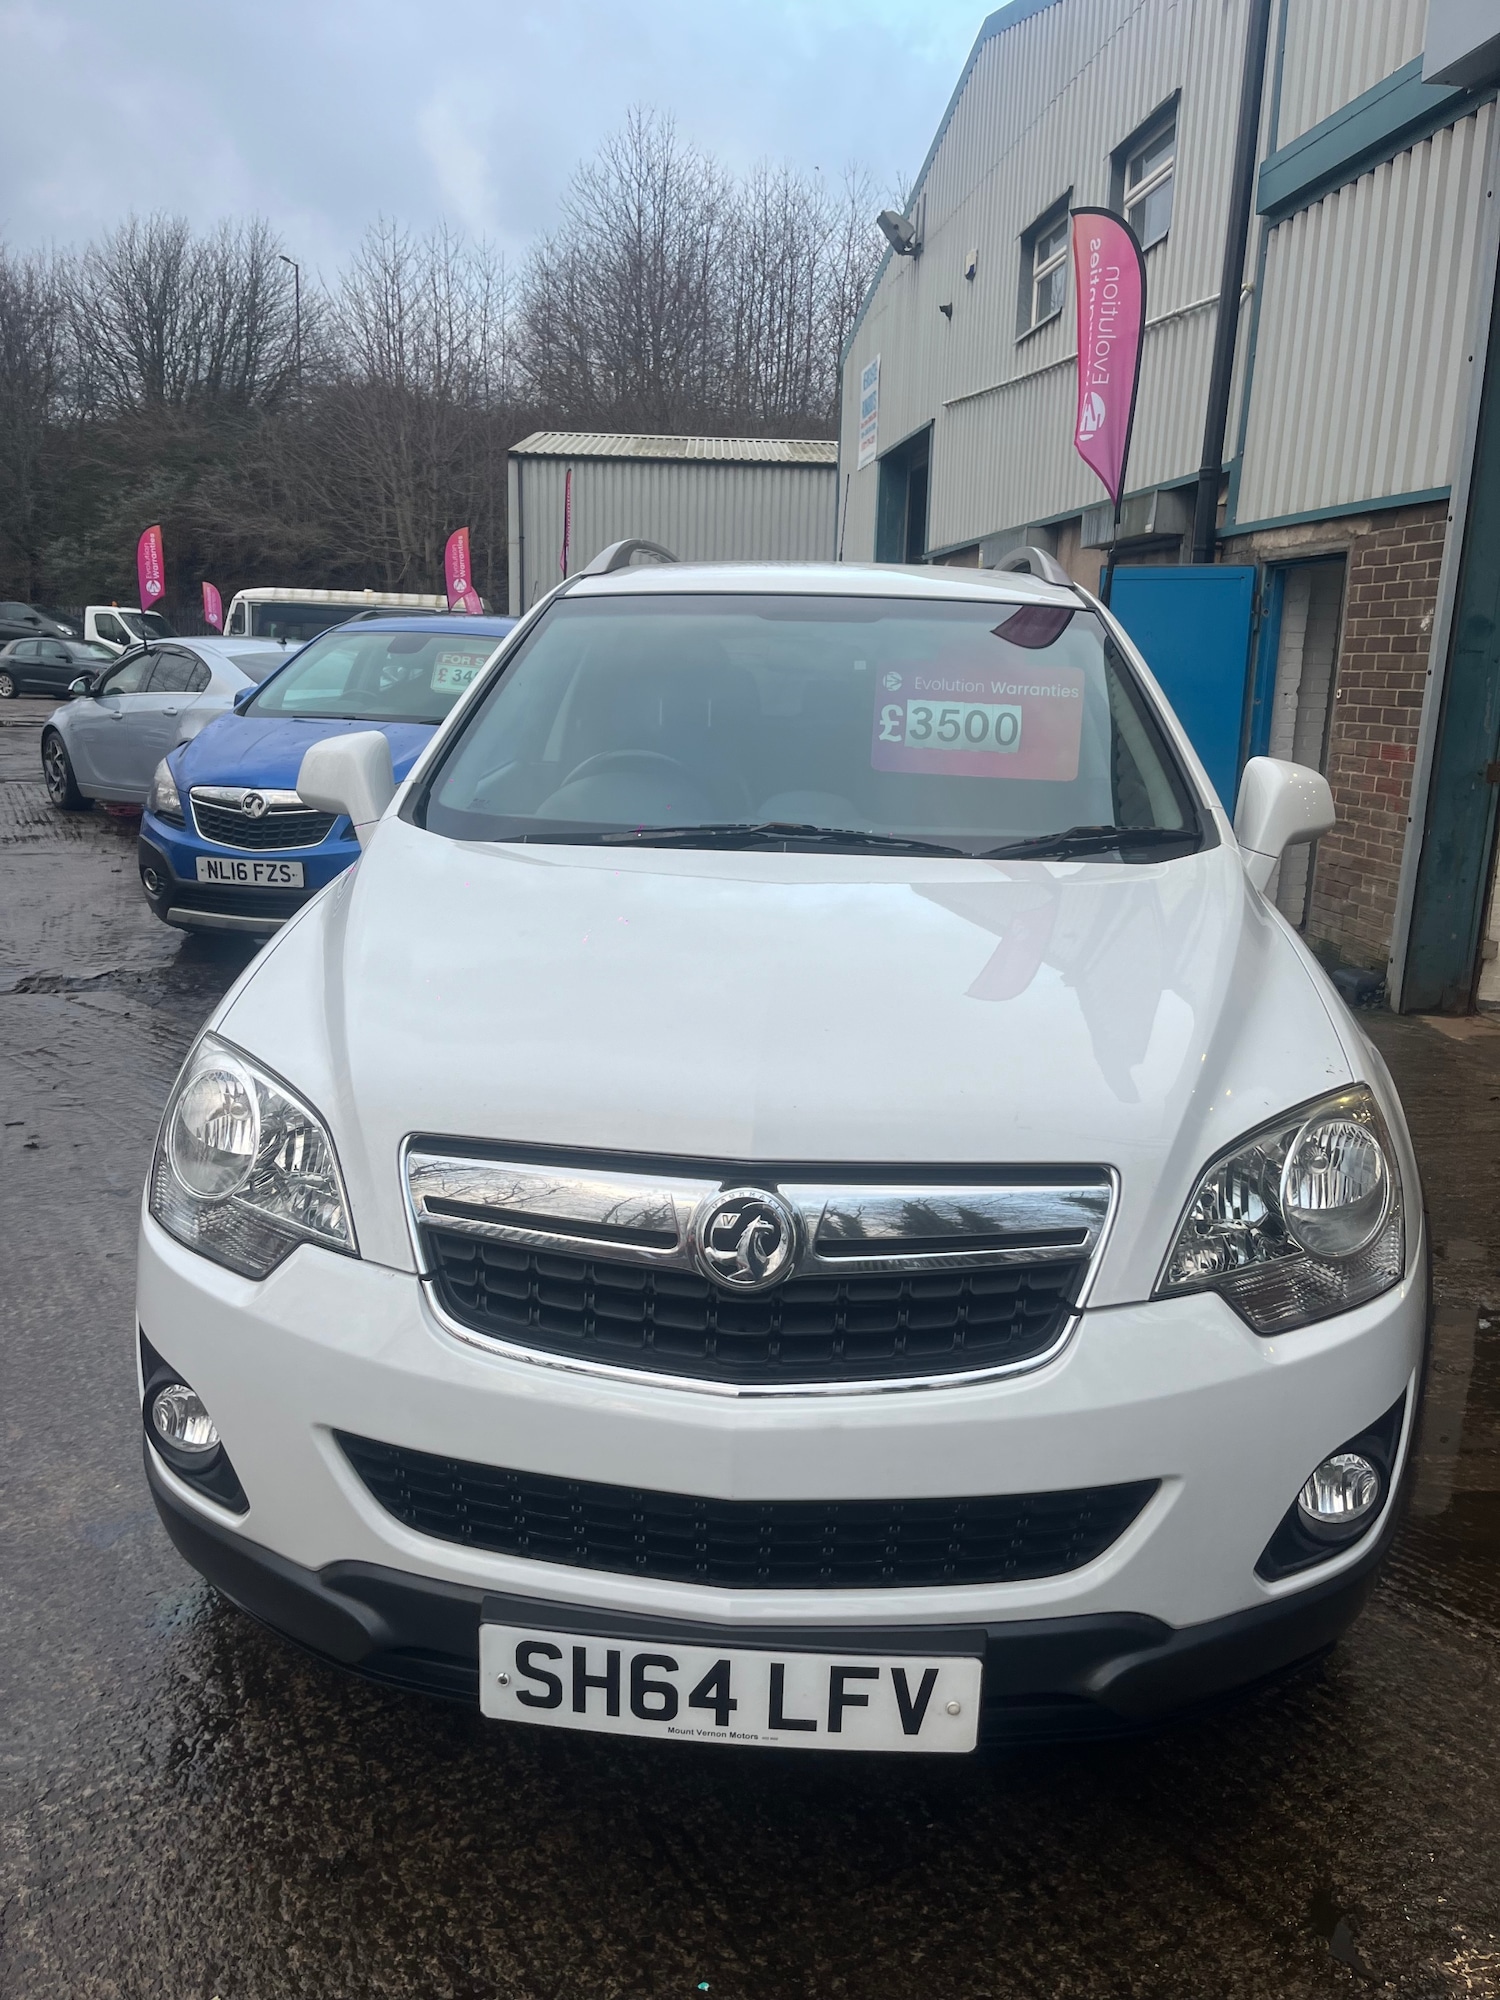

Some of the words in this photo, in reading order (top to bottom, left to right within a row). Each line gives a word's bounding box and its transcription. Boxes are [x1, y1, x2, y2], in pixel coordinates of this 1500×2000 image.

[144, 543, 152, 579] Evolution
[150, 533, 160, 579] Warranties
[458, 536, 466, 578] Warranties
[442, 654, 471, 665] FOR
[915, 676, 985, 694] Evolution
[991, 681, 1079, 698] Warranties
[879, 704, 1019, 746] £3500
[207, 861, 248, 881] NL16
[253, 863, 291, 883] FZS
[515, 1640, 737, 1727] SH64
[768, 1662, 939, 1735] LFV
[667, 1726, 694, 1736] Mount
[696, 1729, 727, 1738] Vernon
[729, 1731, 758, 1740] Motors
